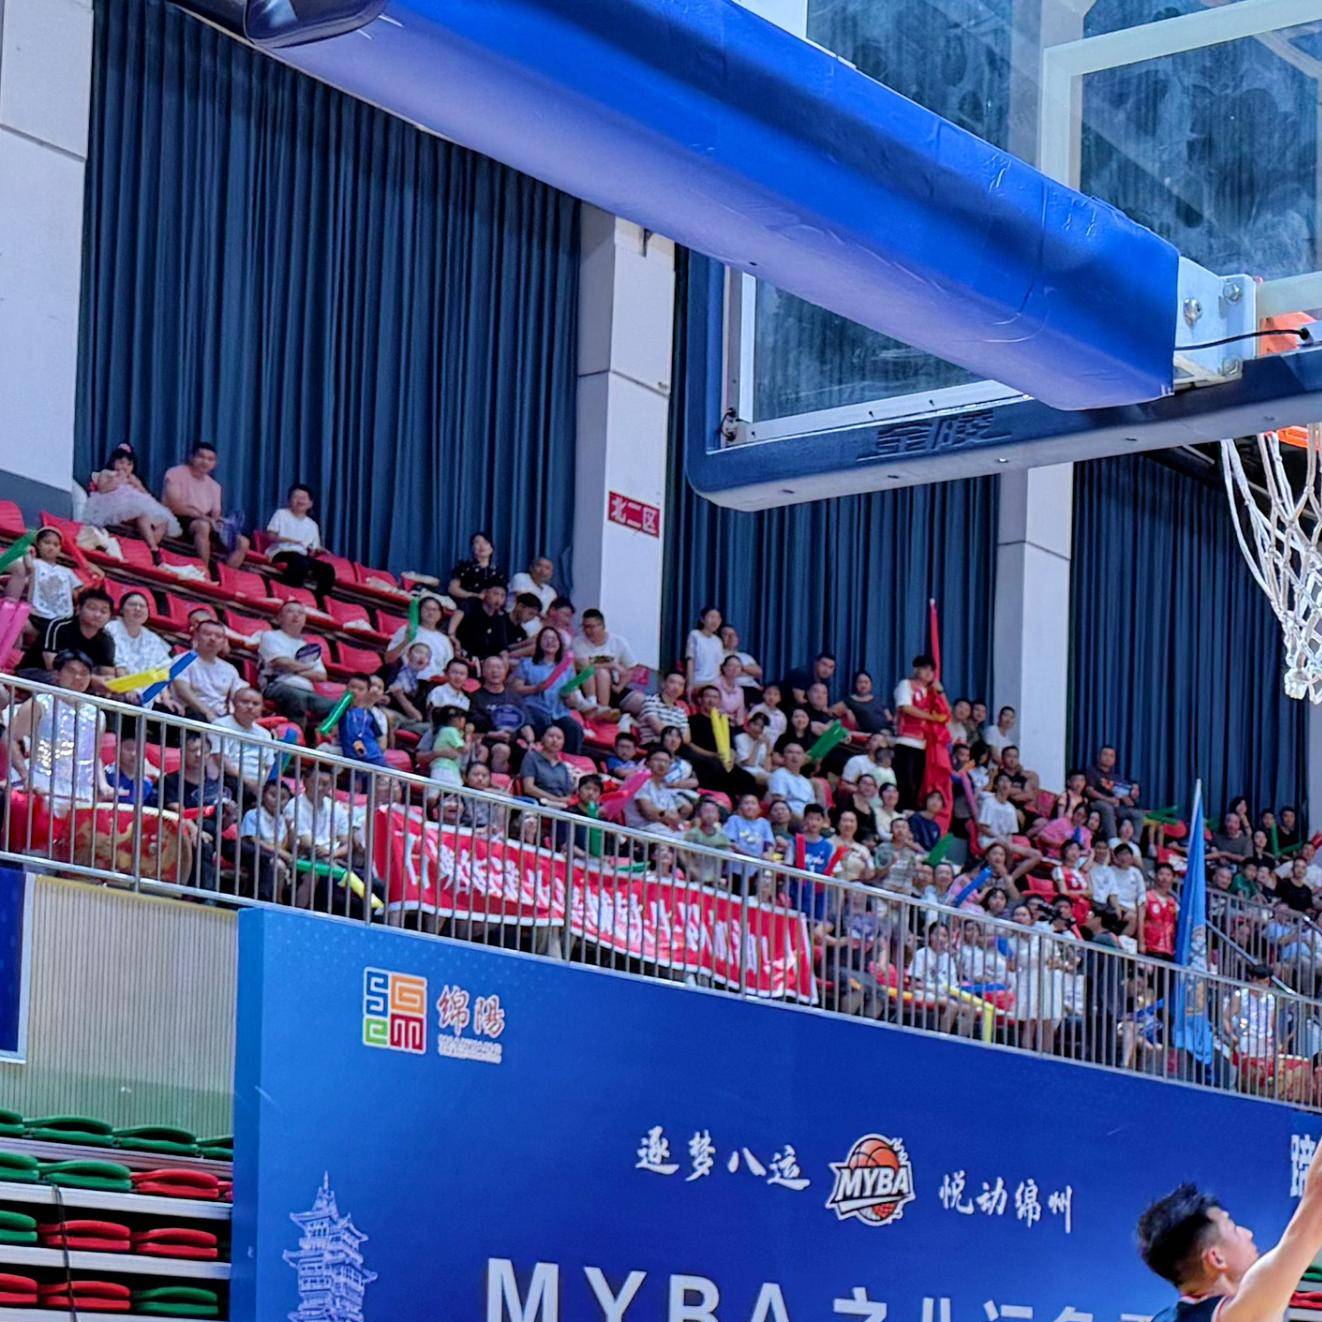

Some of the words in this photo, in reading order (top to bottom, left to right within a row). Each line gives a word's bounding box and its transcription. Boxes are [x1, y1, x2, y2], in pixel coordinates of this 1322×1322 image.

[611, 495, 657, 534] 北二区
[635, 1125, 811, 1191] 逐梦八运
[837, 1165, 911, 1203] MYBA
